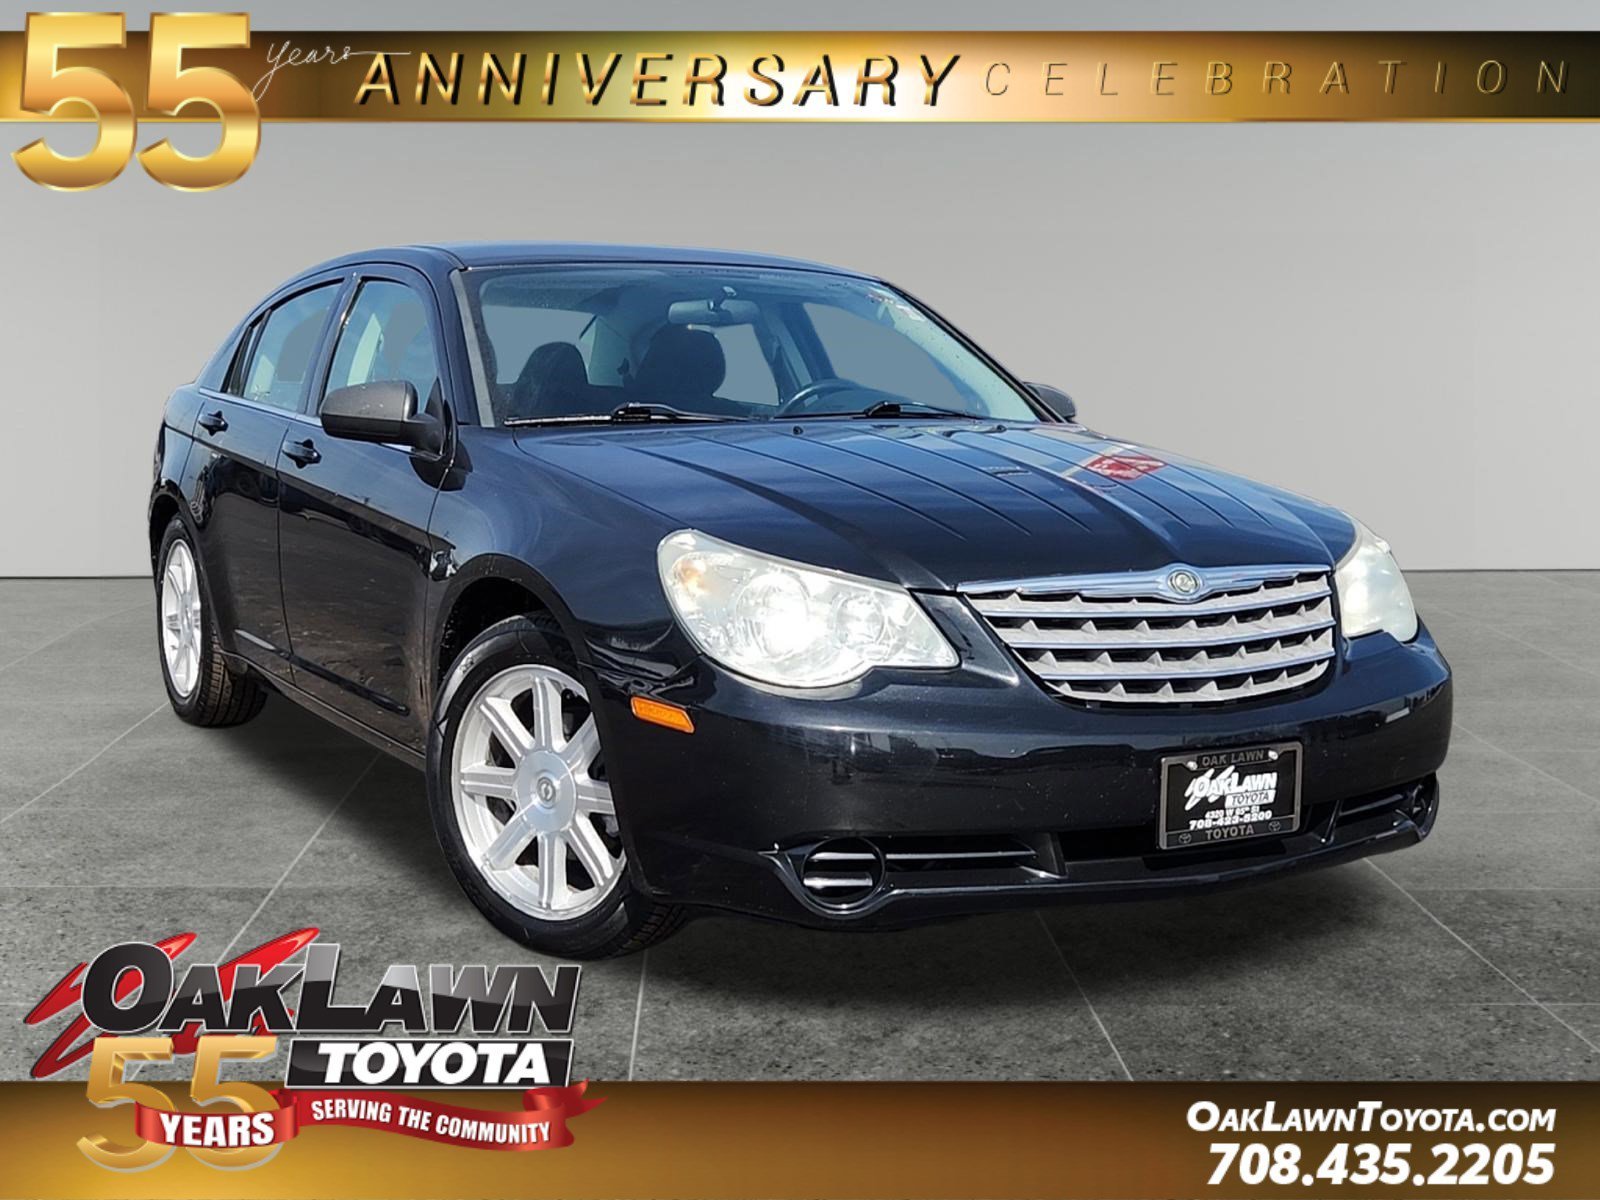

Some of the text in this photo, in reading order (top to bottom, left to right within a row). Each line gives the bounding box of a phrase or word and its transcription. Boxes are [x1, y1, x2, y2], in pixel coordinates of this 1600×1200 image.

[1202, 749, 1265, 767] OAK LAWN
[1231, 792, 1270, 806] TOYOTA
[1205, 824, 1255, 840] TOYOTA
